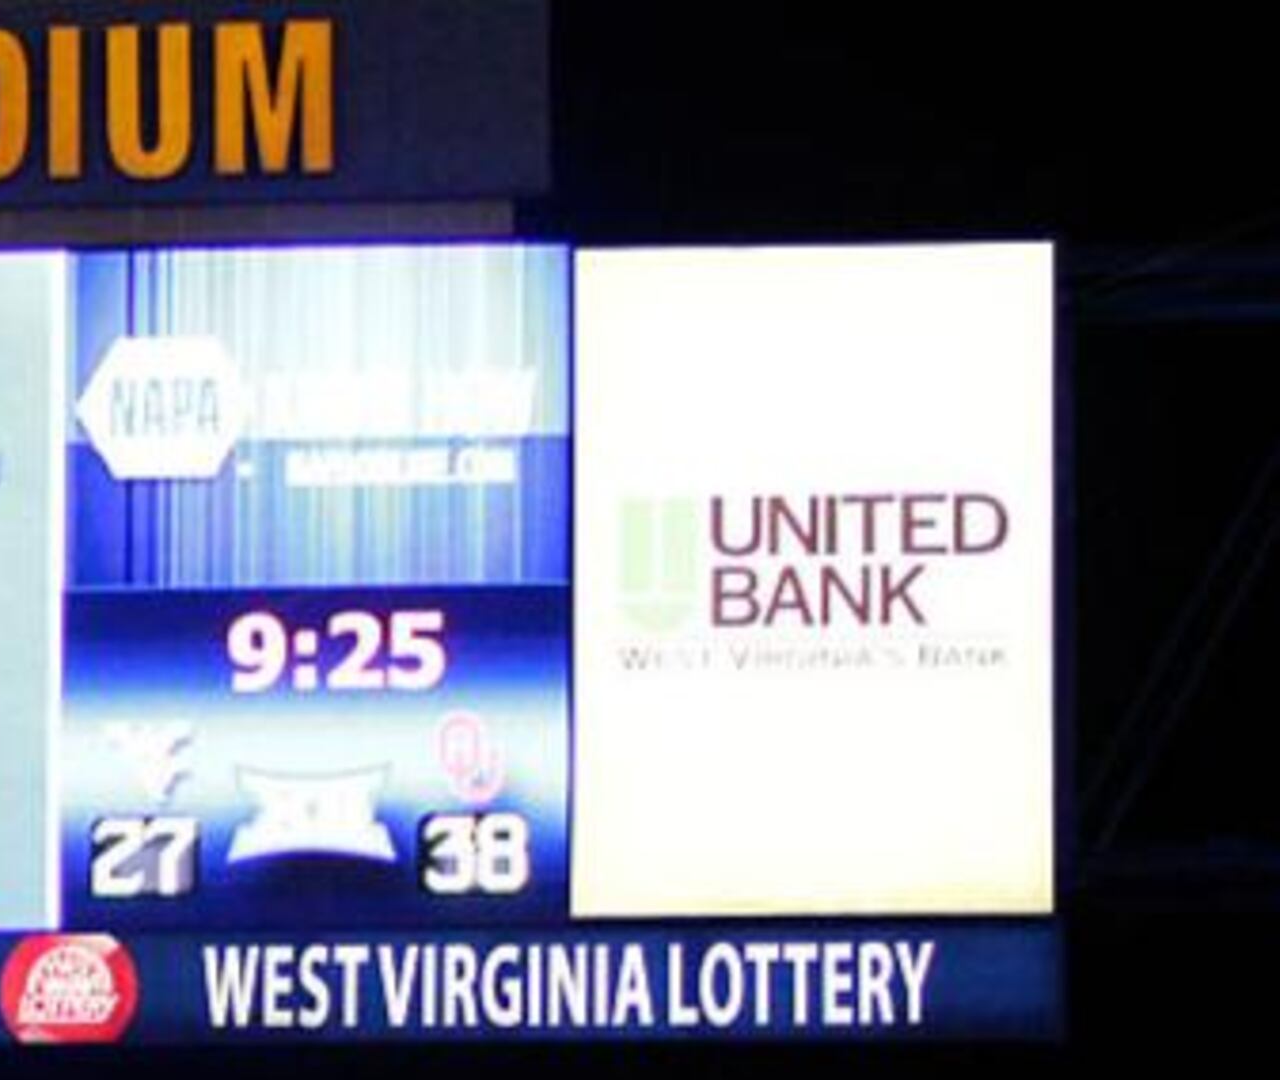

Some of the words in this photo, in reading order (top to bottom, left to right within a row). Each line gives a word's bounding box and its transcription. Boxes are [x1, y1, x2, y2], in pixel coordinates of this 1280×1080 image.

[108, 376, 223, 437] NAPA
[709, 493, 1009, 557] UNITED
[710, 564, 927, 627] BANK
[226, 610, 446, 693] 9:25
[90, 816, 202, 897] 27
[422, 812, 530, 894] 38
[203, 944, 369, 1029] WEST
[378, 943, 652, 1028] VIRGINIA
[665, 941, 935, 1026] LOTTERY
